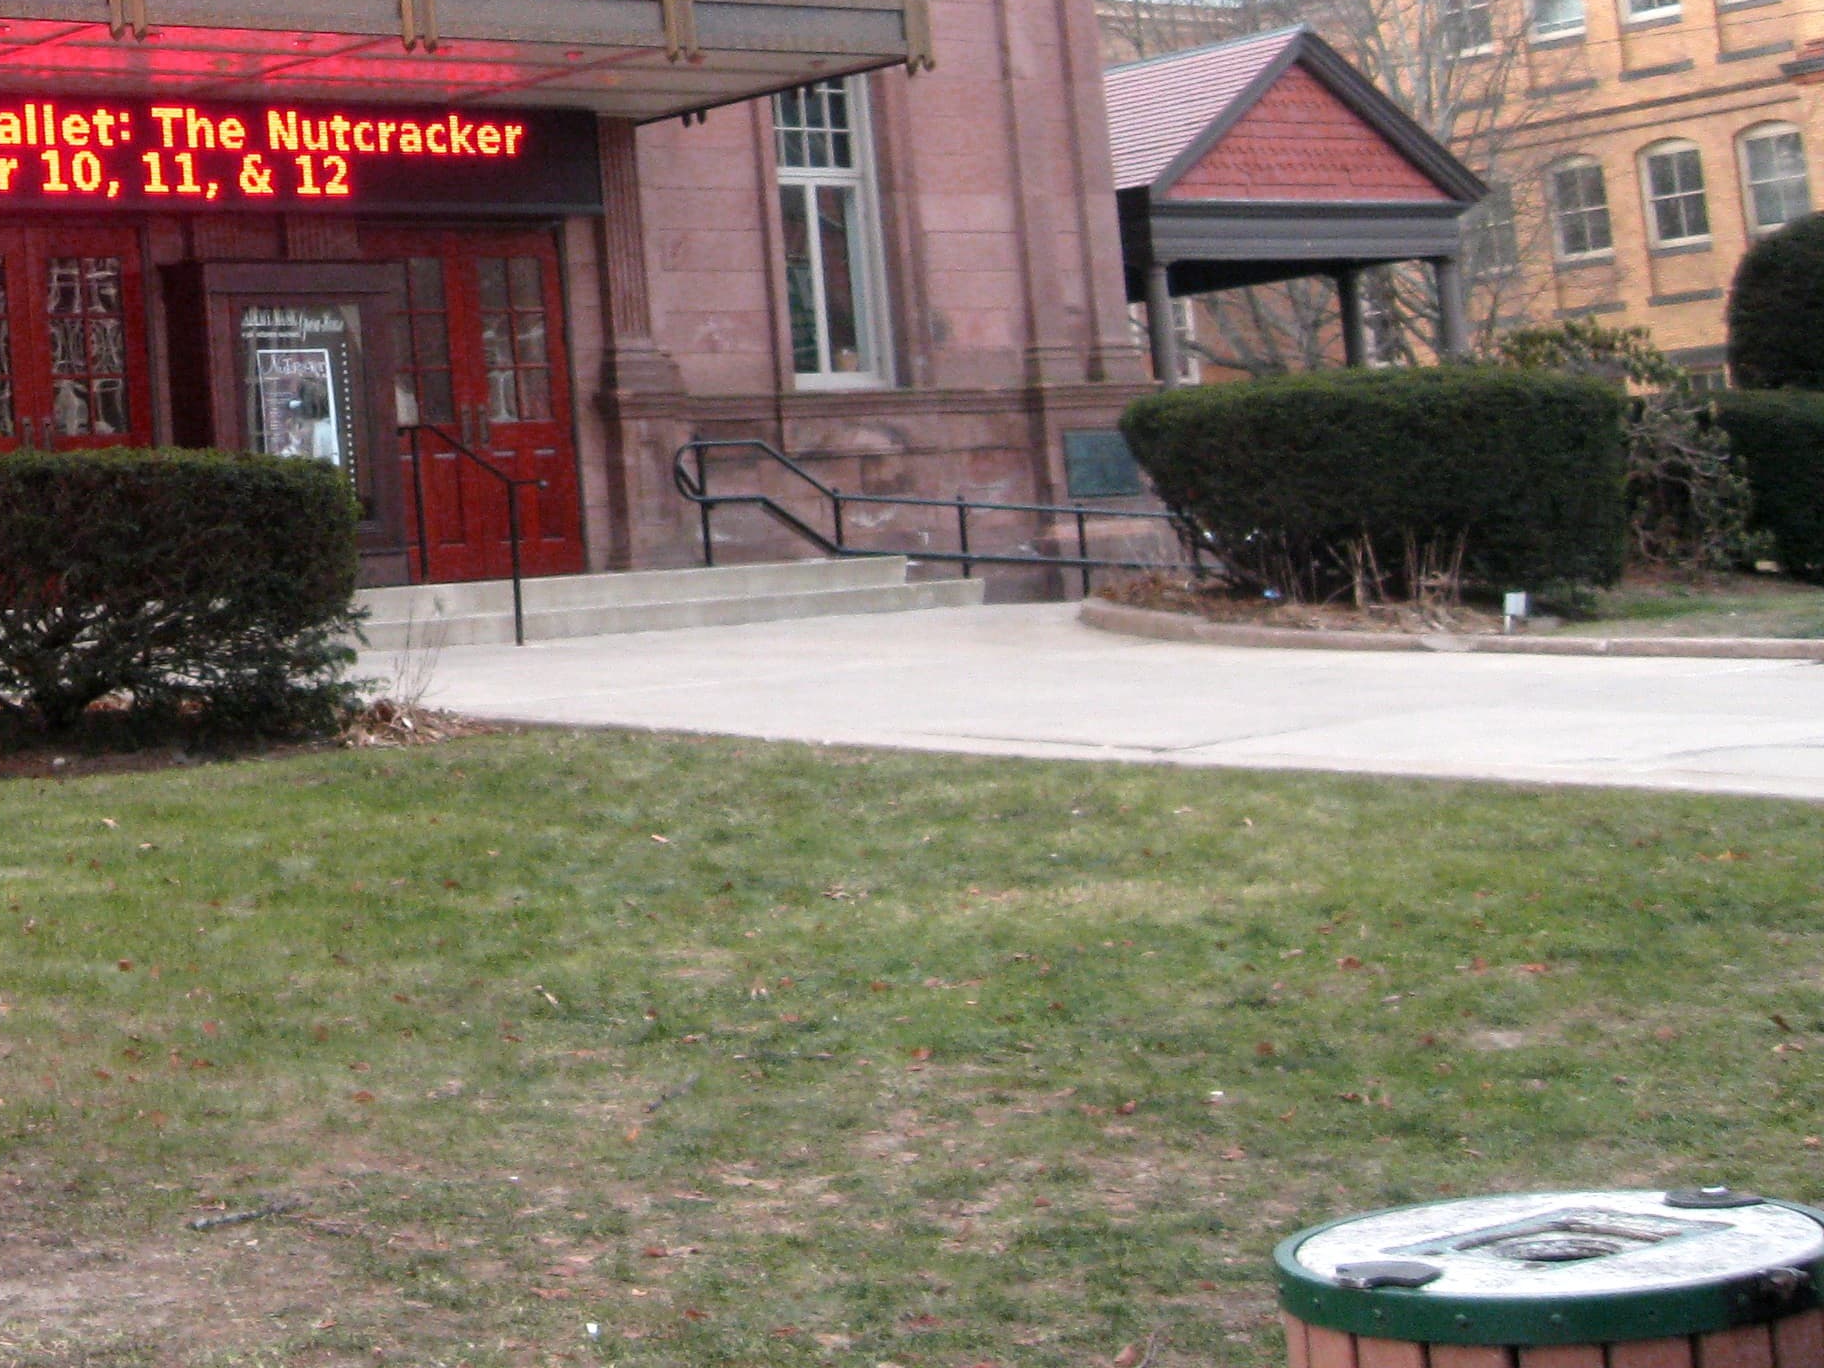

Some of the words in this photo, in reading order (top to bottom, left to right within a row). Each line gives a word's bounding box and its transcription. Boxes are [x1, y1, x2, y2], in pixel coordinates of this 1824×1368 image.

[151, 107, 246, 149] The
[267, 110, 523, 154] Nutcracker
[40, 149, 120, 198] 10,
[142, 152, 218, 199] 11,
[239, 153, 274, 194] &
[295, 154, 349, 195] 12
